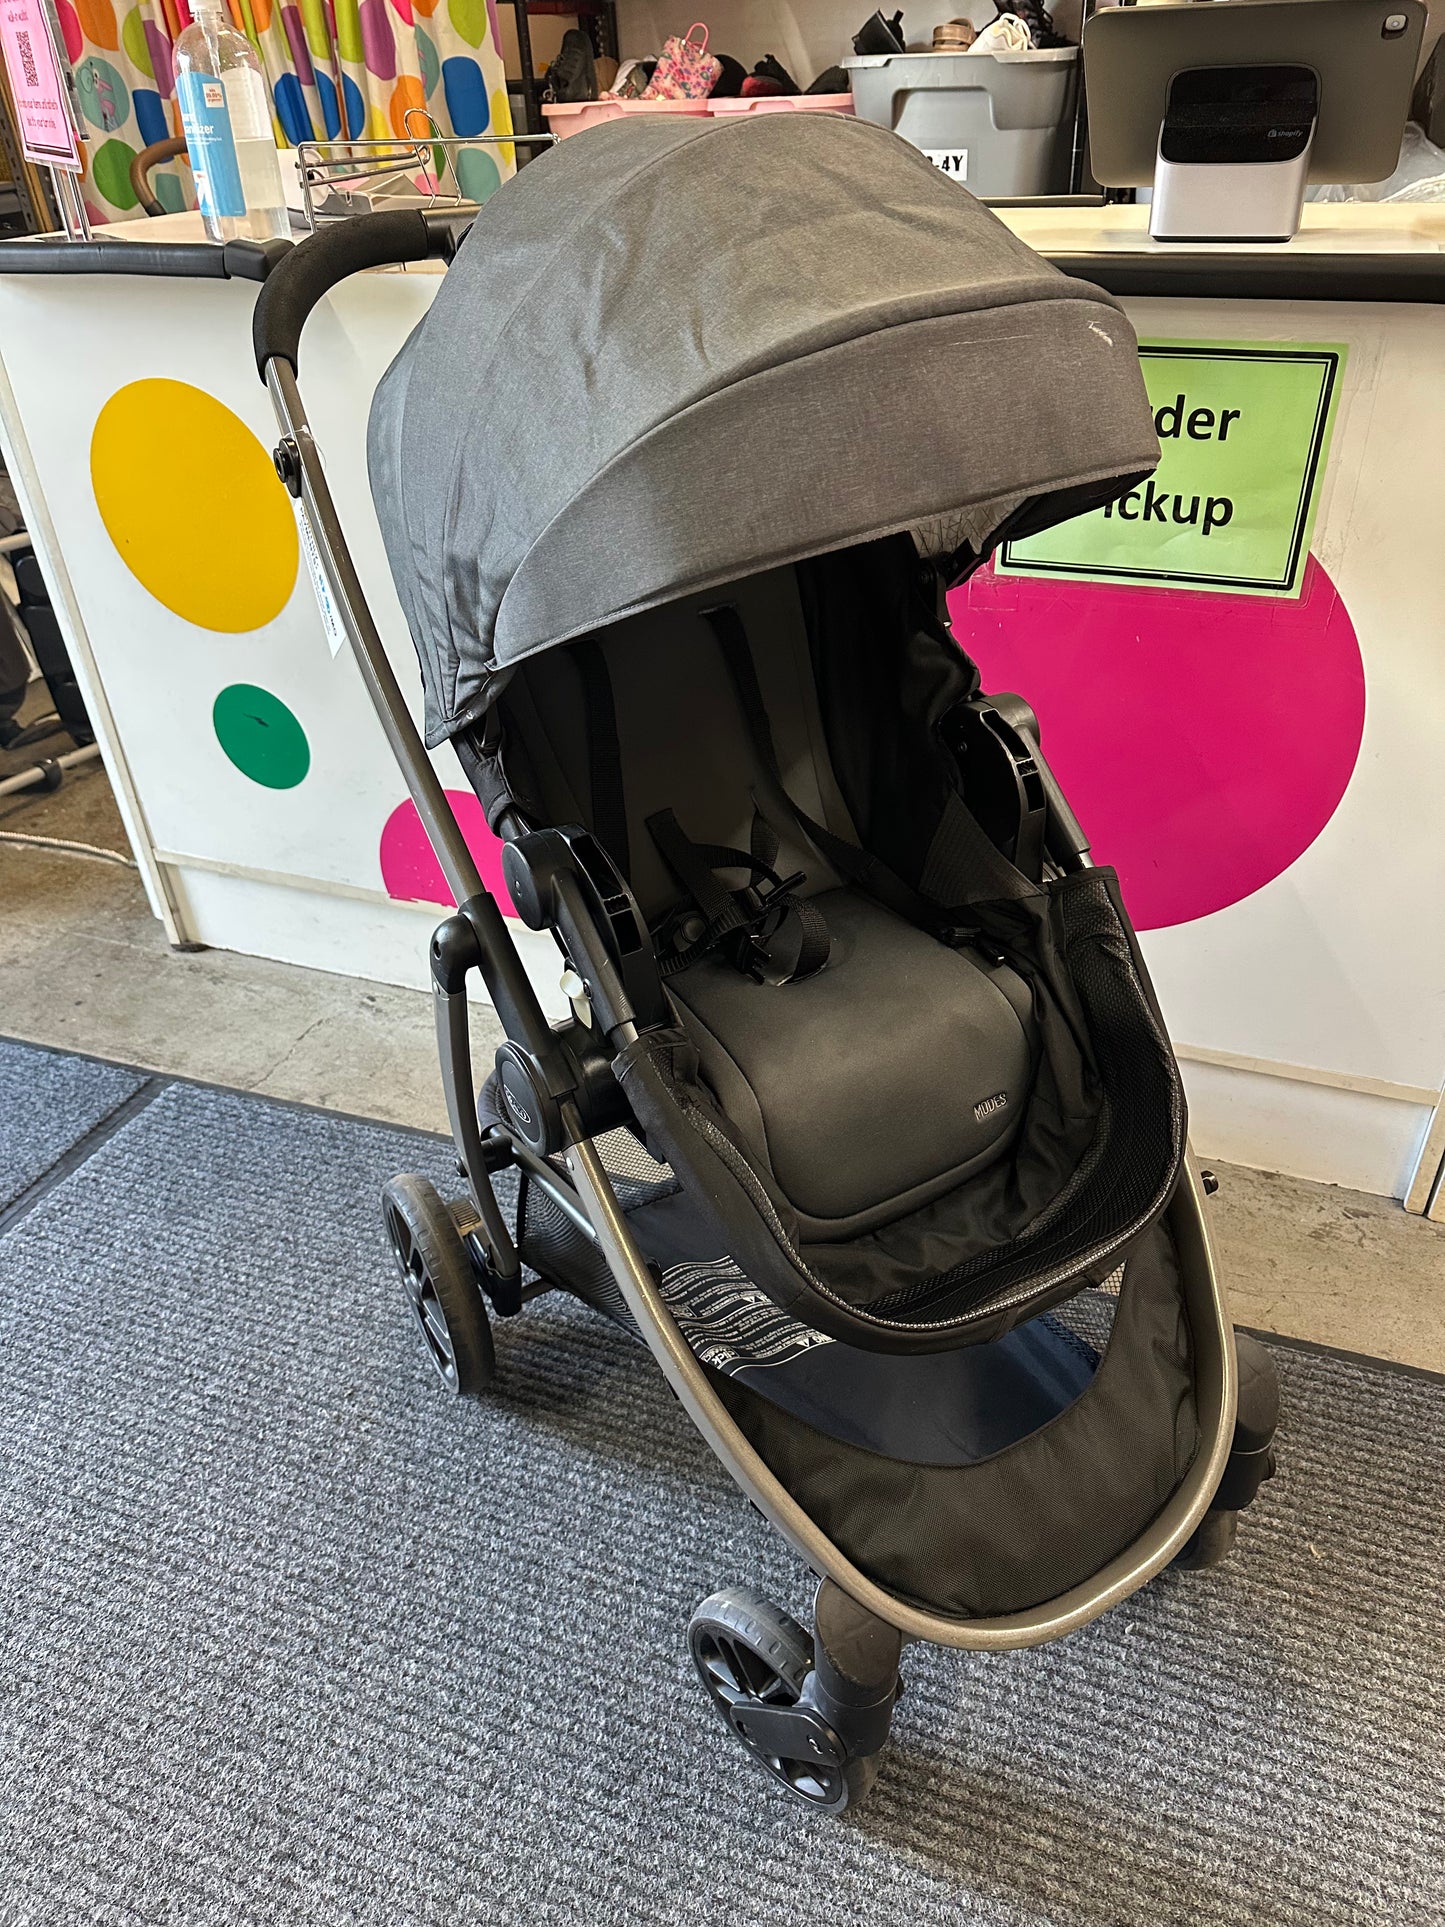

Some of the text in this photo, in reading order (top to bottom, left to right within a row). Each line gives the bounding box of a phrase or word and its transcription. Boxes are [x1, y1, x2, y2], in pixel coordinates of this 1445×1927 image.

[1277, 130, 1303, 138] shopify
[1149, 394, 1241, 441] der
[973, 1092, 1007, 1121] MODES
